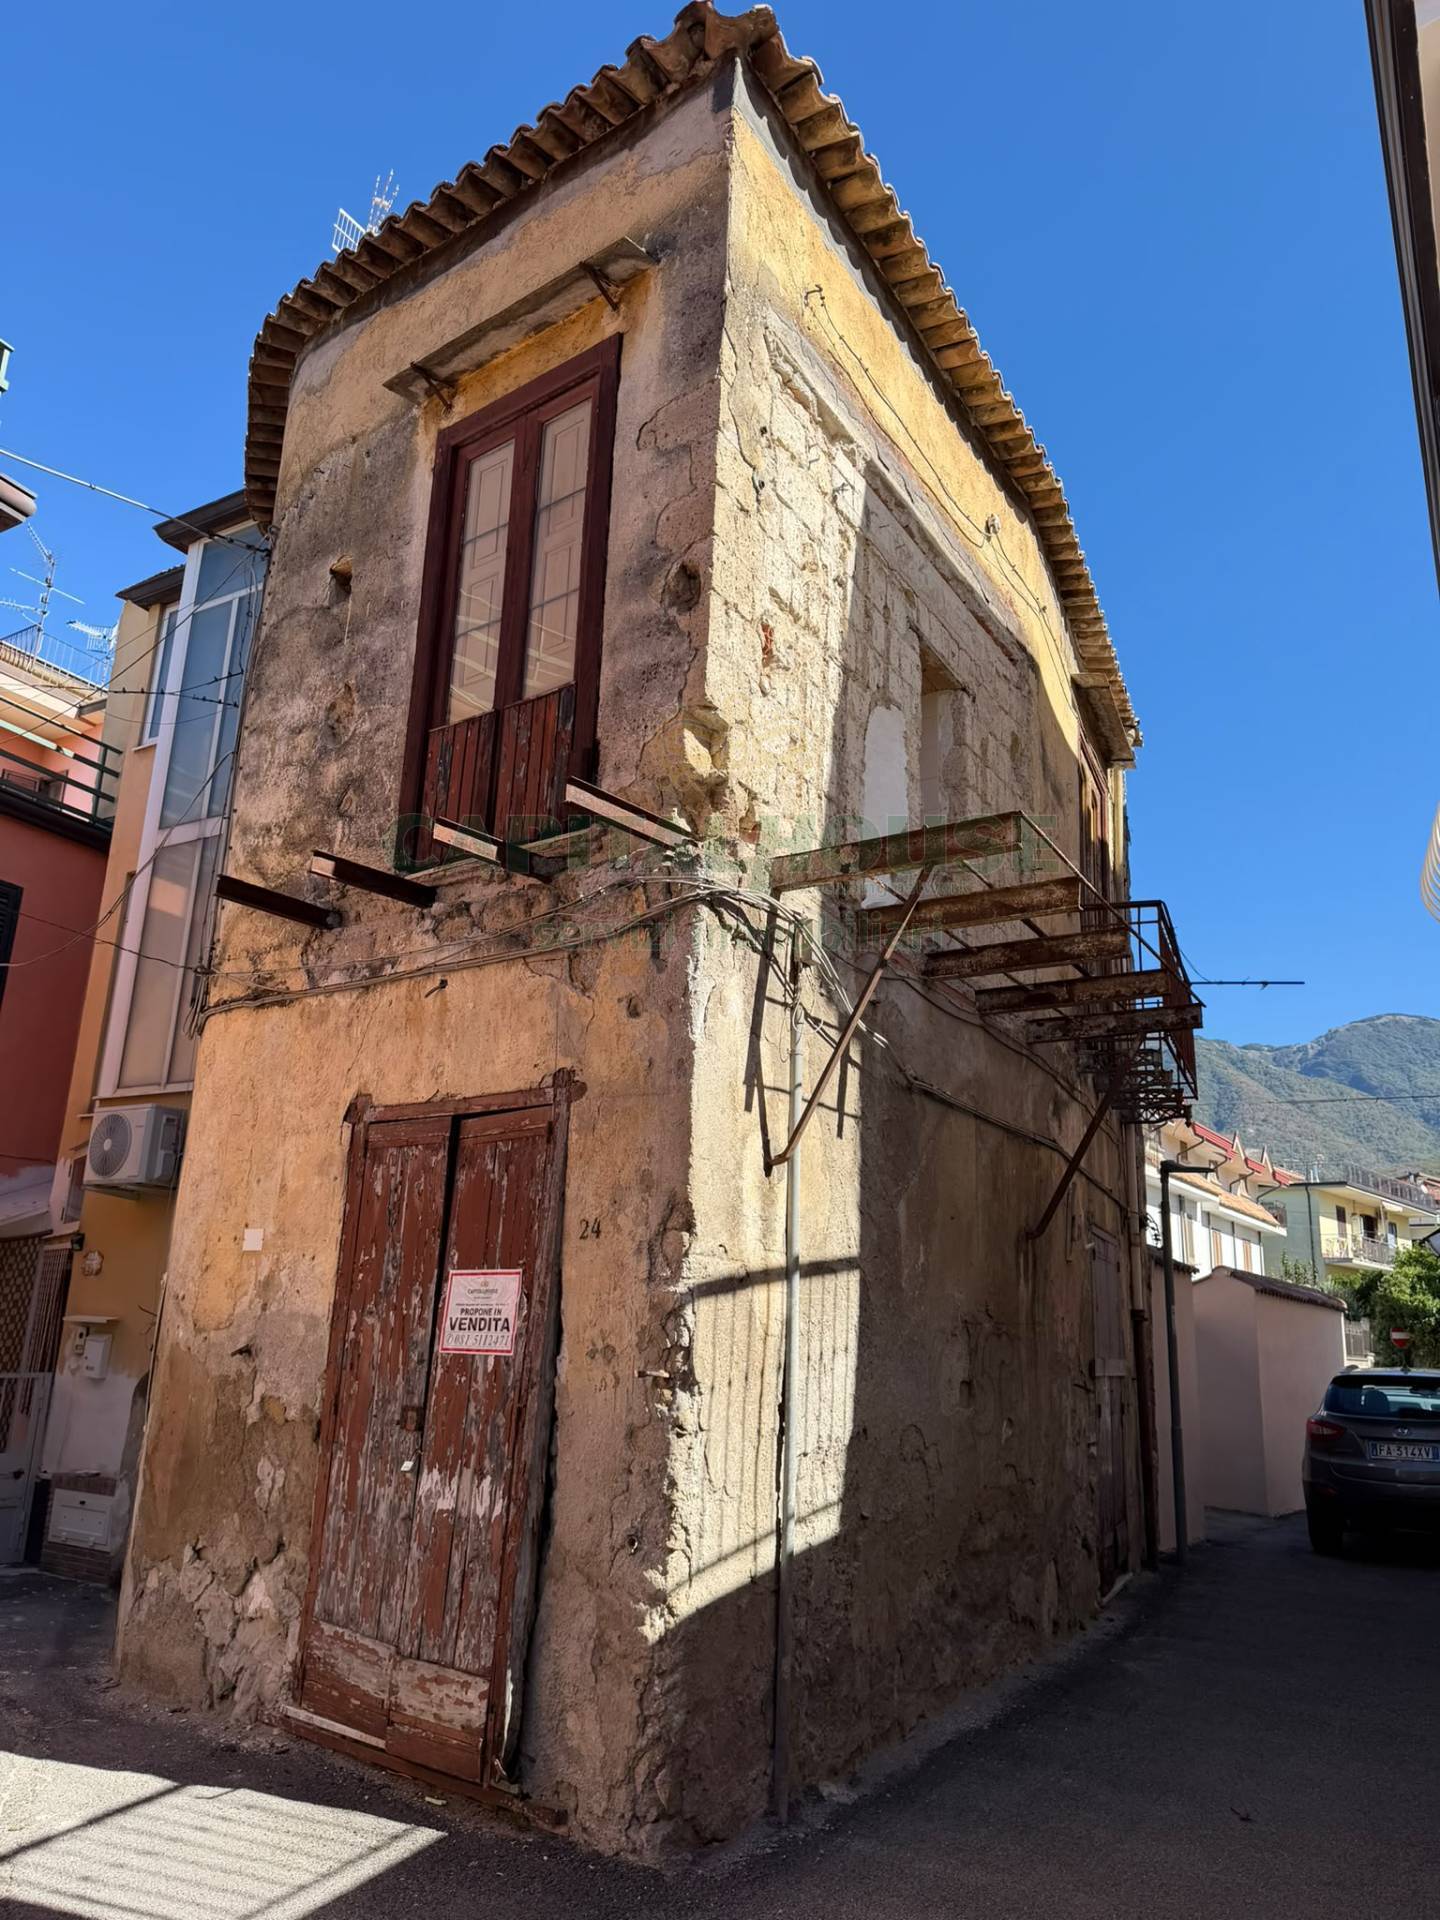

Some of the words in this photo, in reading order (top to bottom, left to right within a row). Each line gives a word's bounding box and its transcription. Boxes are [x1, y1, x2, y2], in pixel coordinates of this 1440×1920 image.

[578, 1217, 602, 1240] 24
[460, 1308, 493, 1316] PROPONE
[494, 1308, 503, 1316] IN
[449, 1317, 511, 1332] VENDITA
